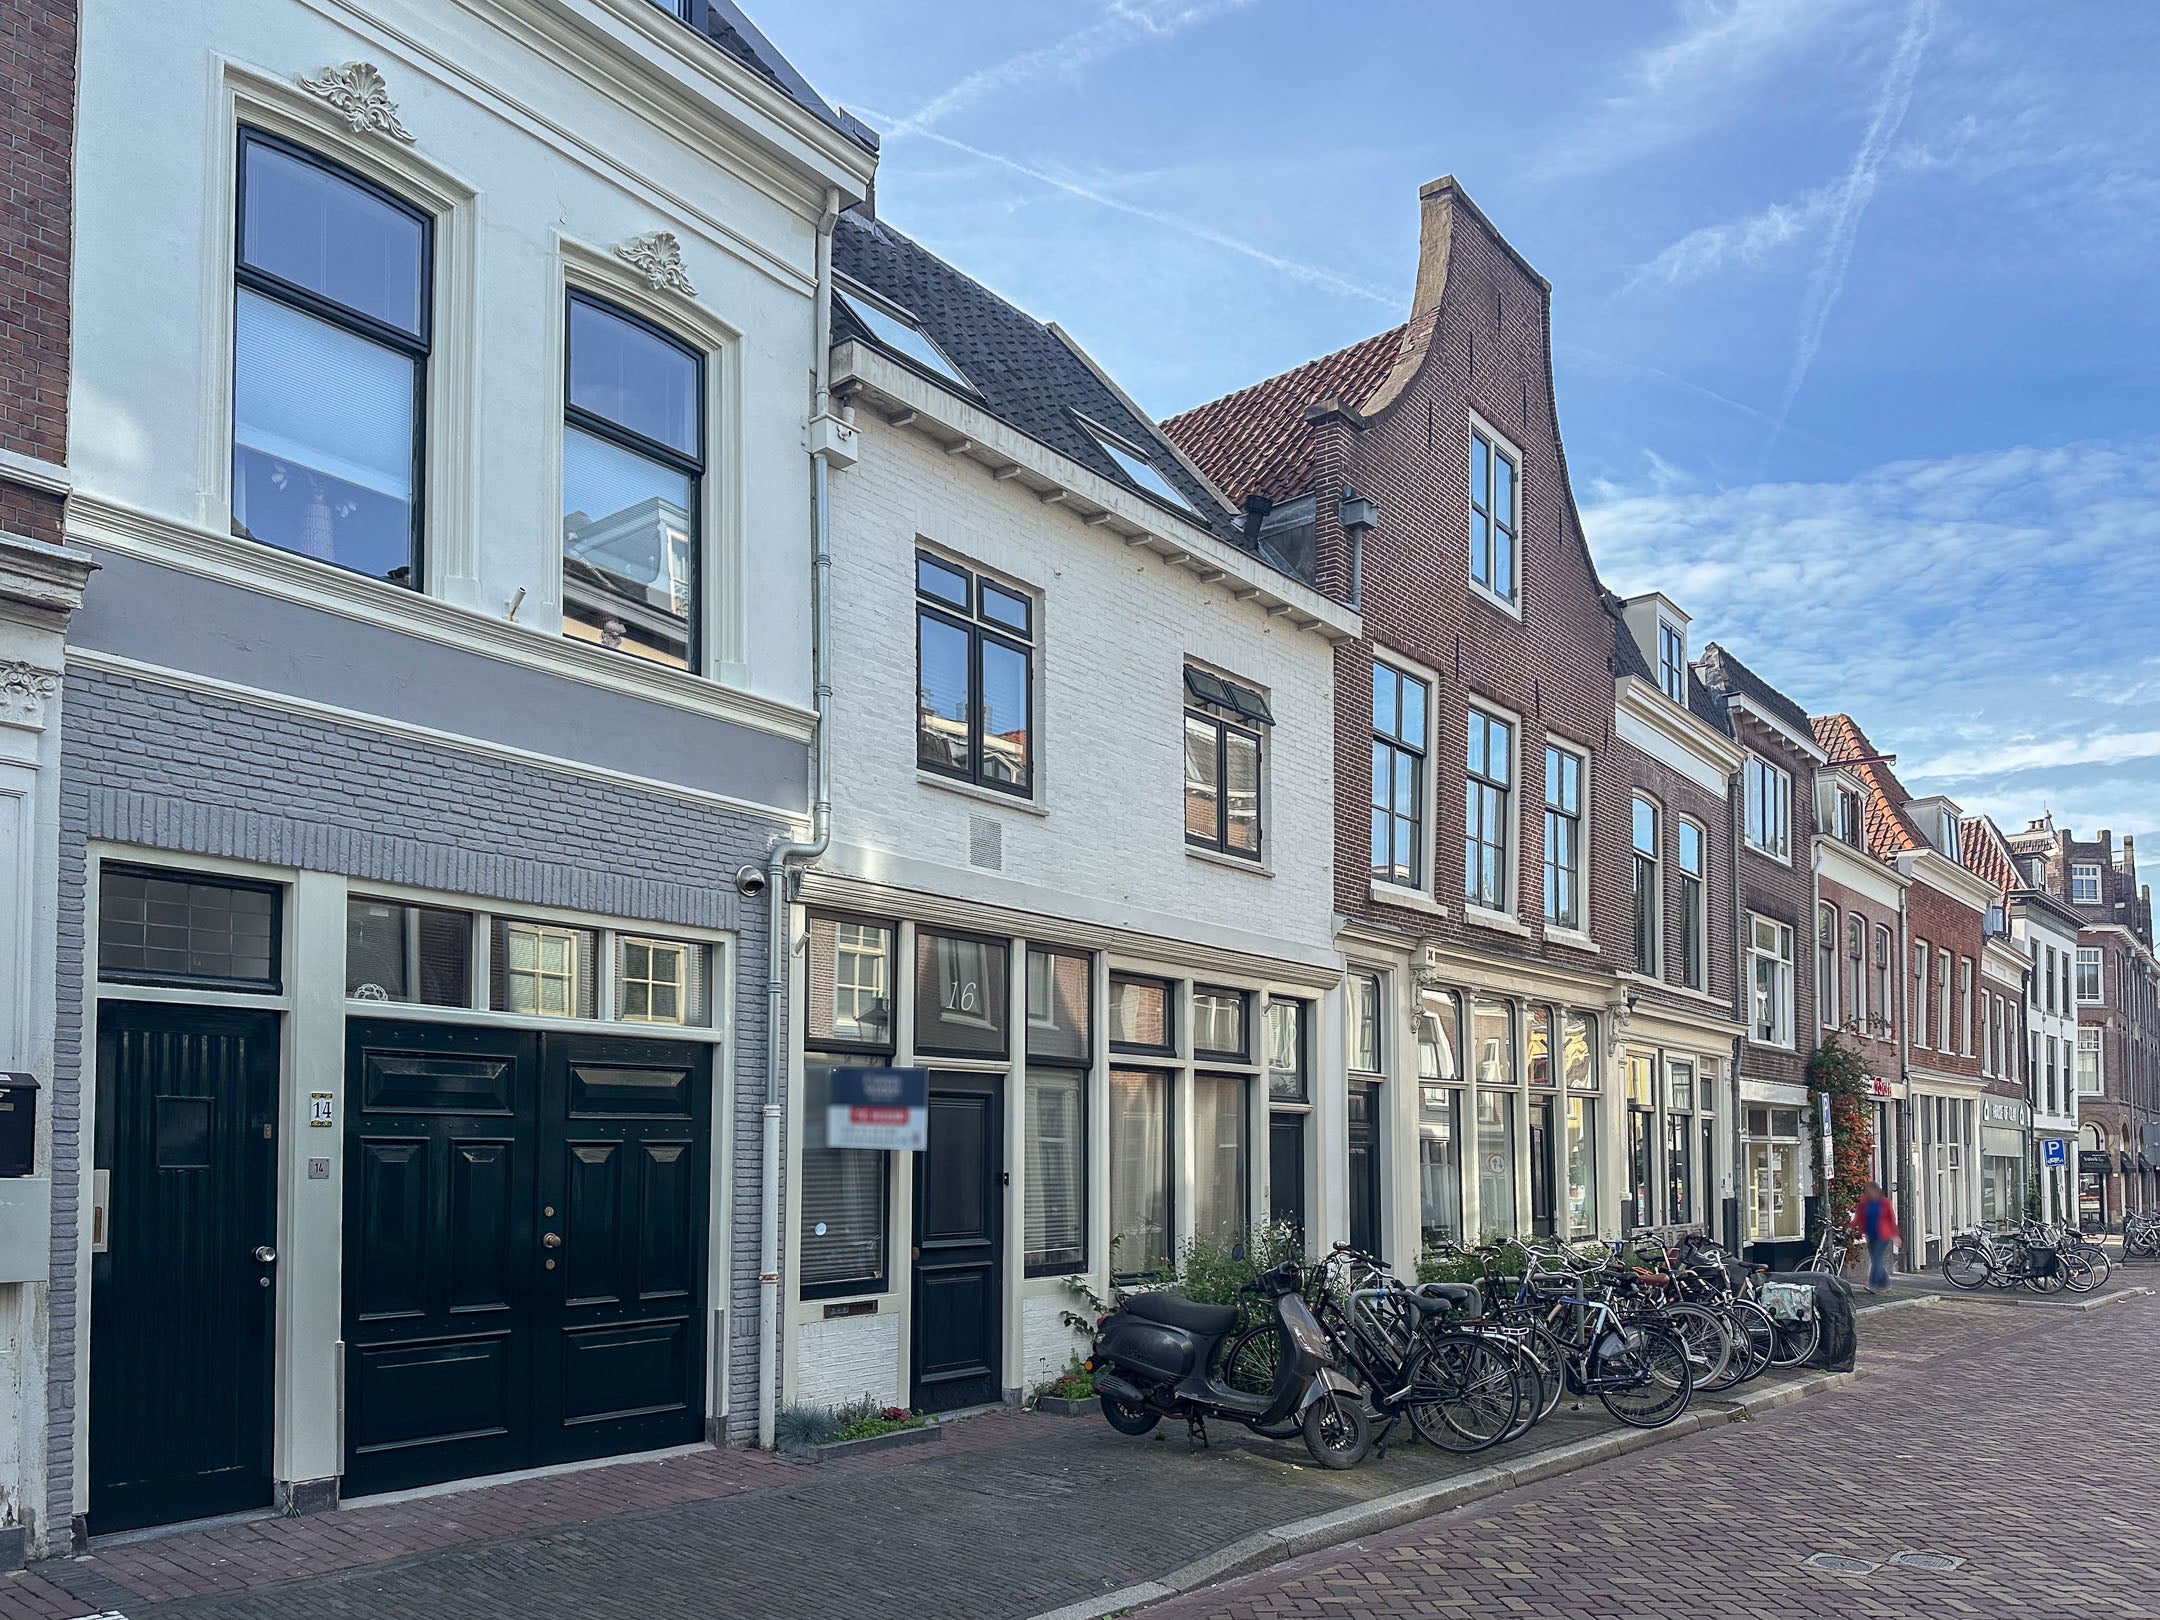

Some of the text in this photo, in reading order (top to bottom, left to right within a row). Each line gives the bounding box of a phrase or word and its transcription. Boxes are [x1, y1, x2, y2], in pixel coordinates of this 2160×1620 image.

[945, 981, 977, 1011] 16
[312, 1101, 332, 1119] 14
[2047, 1141, 2060, 1156] P
[314, 1162, 324, 1173] 14
